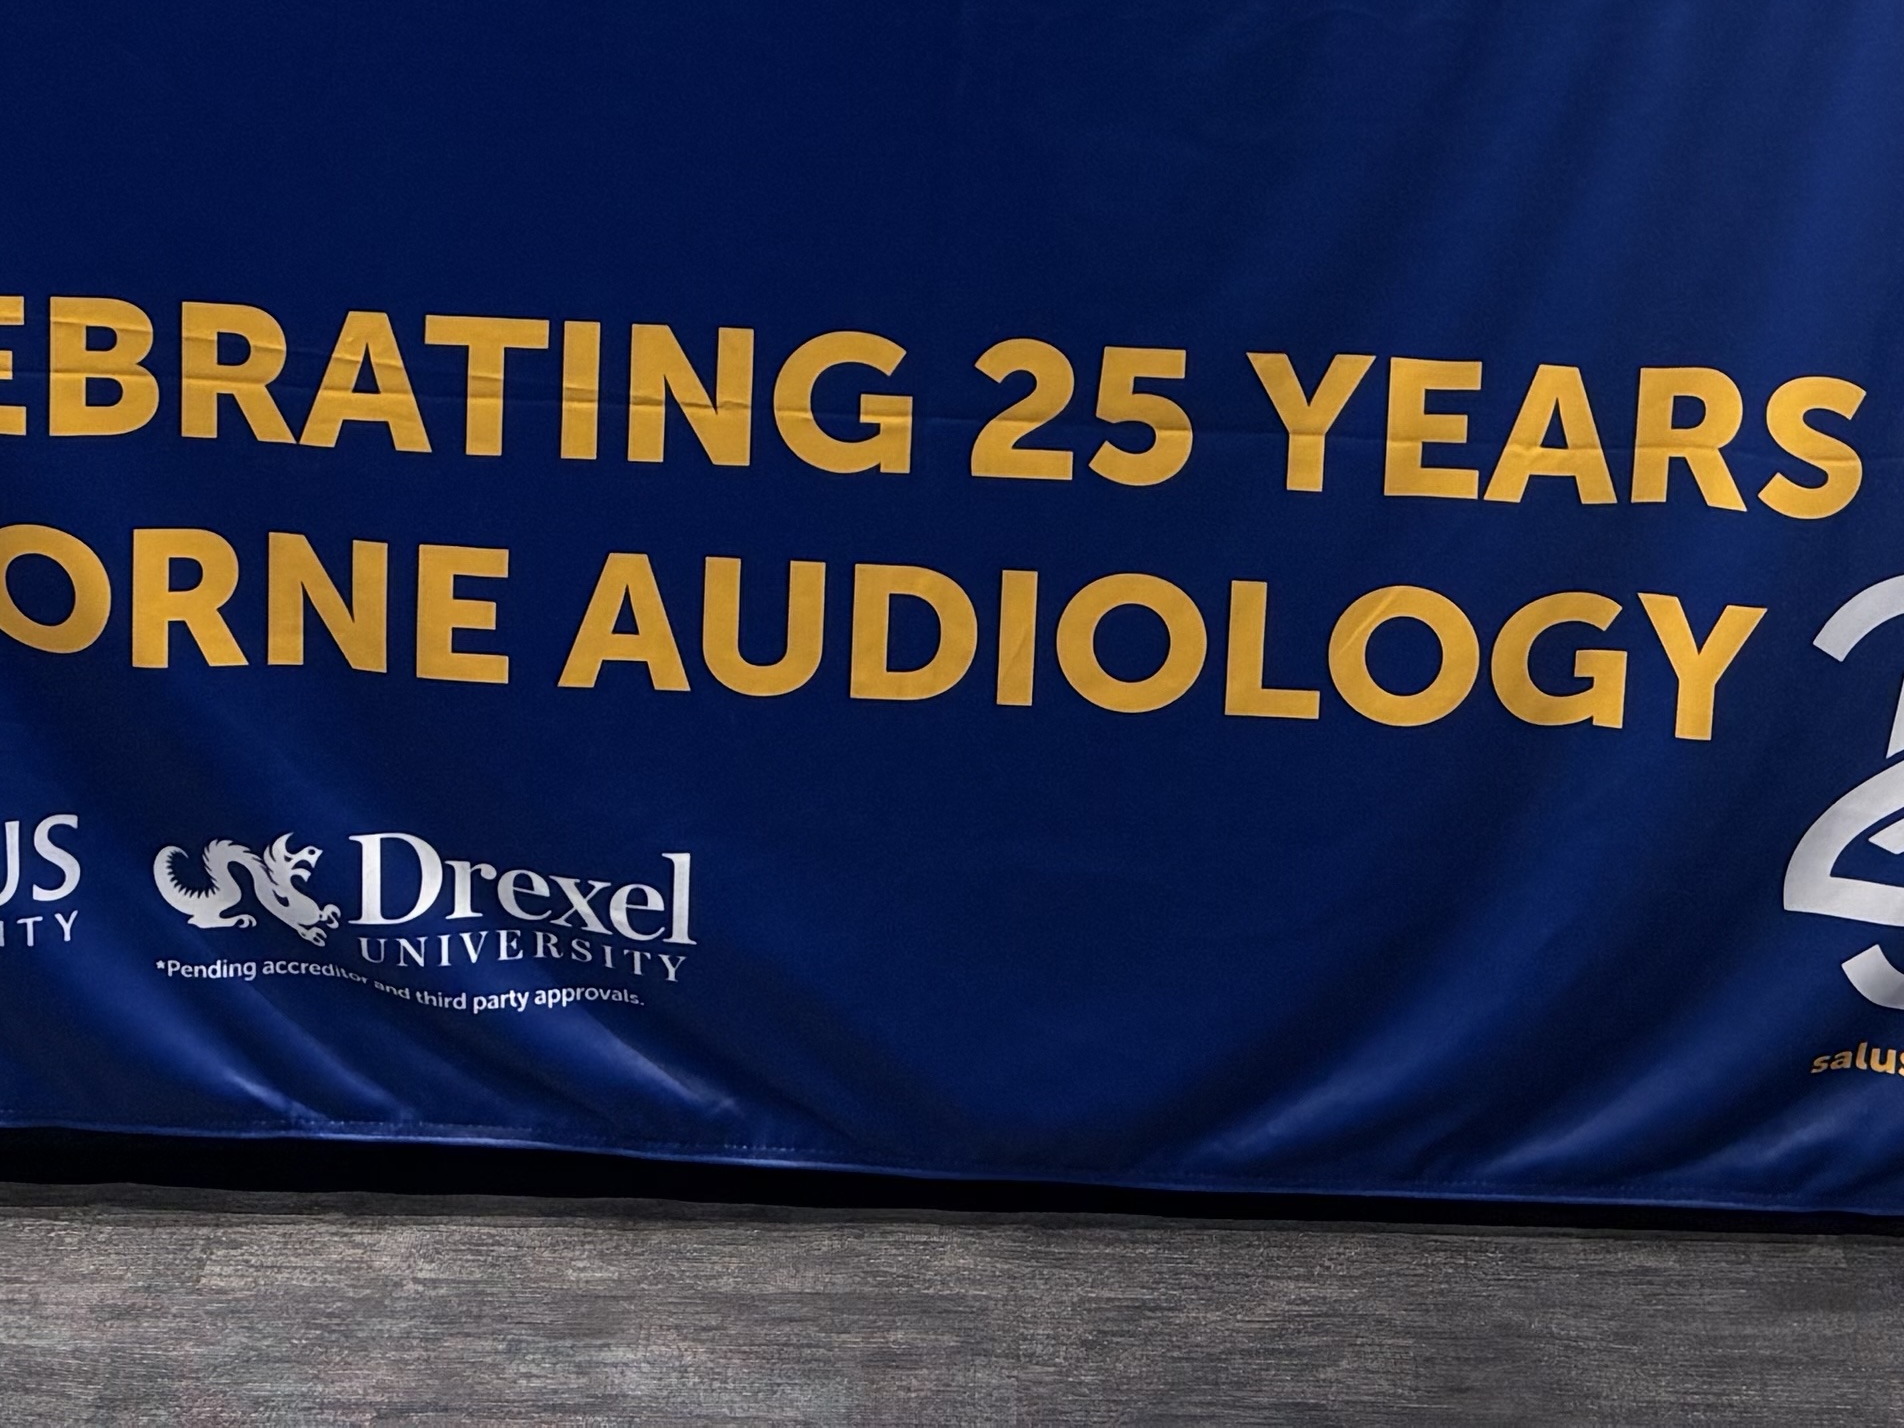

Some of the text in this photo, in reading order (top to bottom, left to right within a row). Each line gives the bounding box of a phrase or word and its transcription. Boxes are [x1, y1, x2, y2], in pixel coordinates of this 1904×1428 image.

[971, 337, 1194, 486] 25
[1246, 352, 1868, 520] YEARS
[558, 550, 1767, 741] AUDIOLOGY
[348, 830, 697, 946] Drexel
[358, 930, 686, 982] UNIVERSITY
[373, 979, 410, 1000] and
[416, 989, 466, 1010] third
[473, 991, 529, 1015] party
[534, 985, 644, 1010] approvals.
